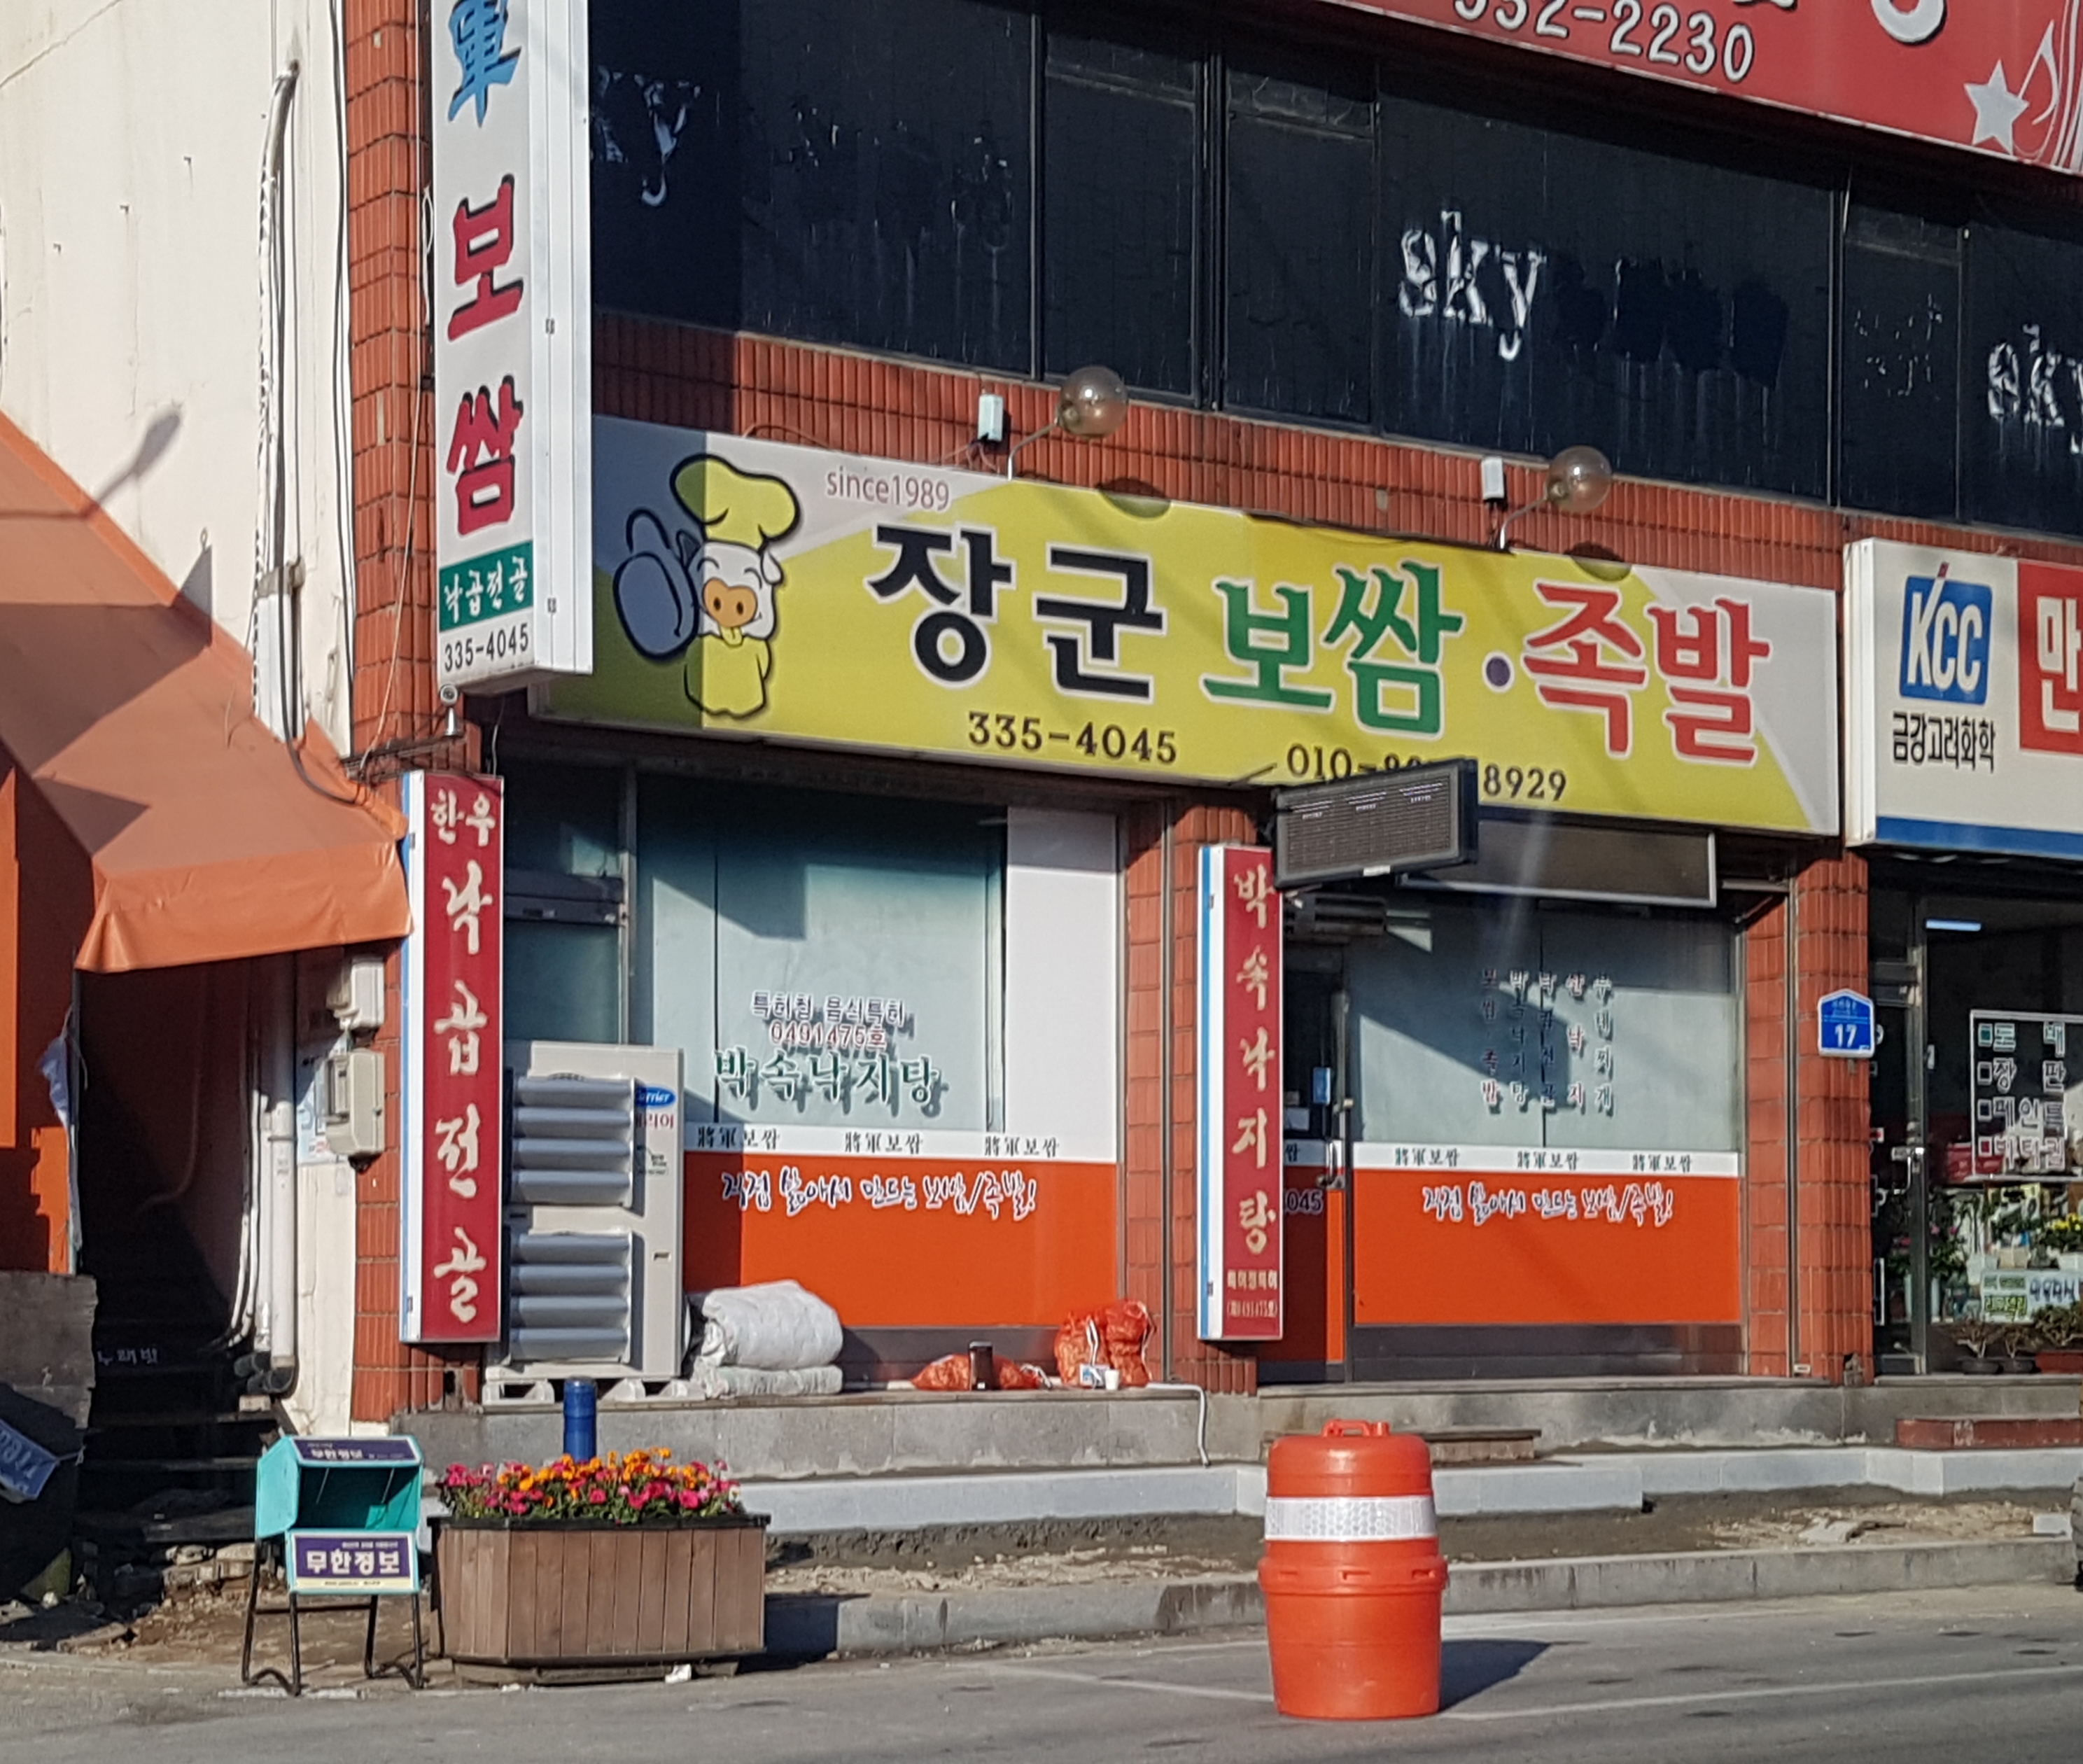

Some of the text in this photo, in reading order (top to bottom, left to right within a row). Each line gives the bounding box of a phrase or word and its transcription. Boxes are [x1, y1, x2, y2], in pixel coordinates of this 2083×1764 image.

[827, 465, 949, 512] since1989
[444, 556, 528, 623] 낙곱전골
[864, 522, 1167, 702] 장군
[444, 622, 528, 672] 335-4045
[1907, 562, 1983, 693] KCC
[969, 710, 1177, 764] 335-4045
[1893, 711, 1996, 774] 금강고려화학
[431, 788, 496, 846] 한우
[1232, 864, 1277, 1254] 박속낙지탕
[1835, 1023, 1858, 1048] 17
[433, 860, 493, 1324] 낙곱전골
[307, 1548, 400, 1576] 무한정보
